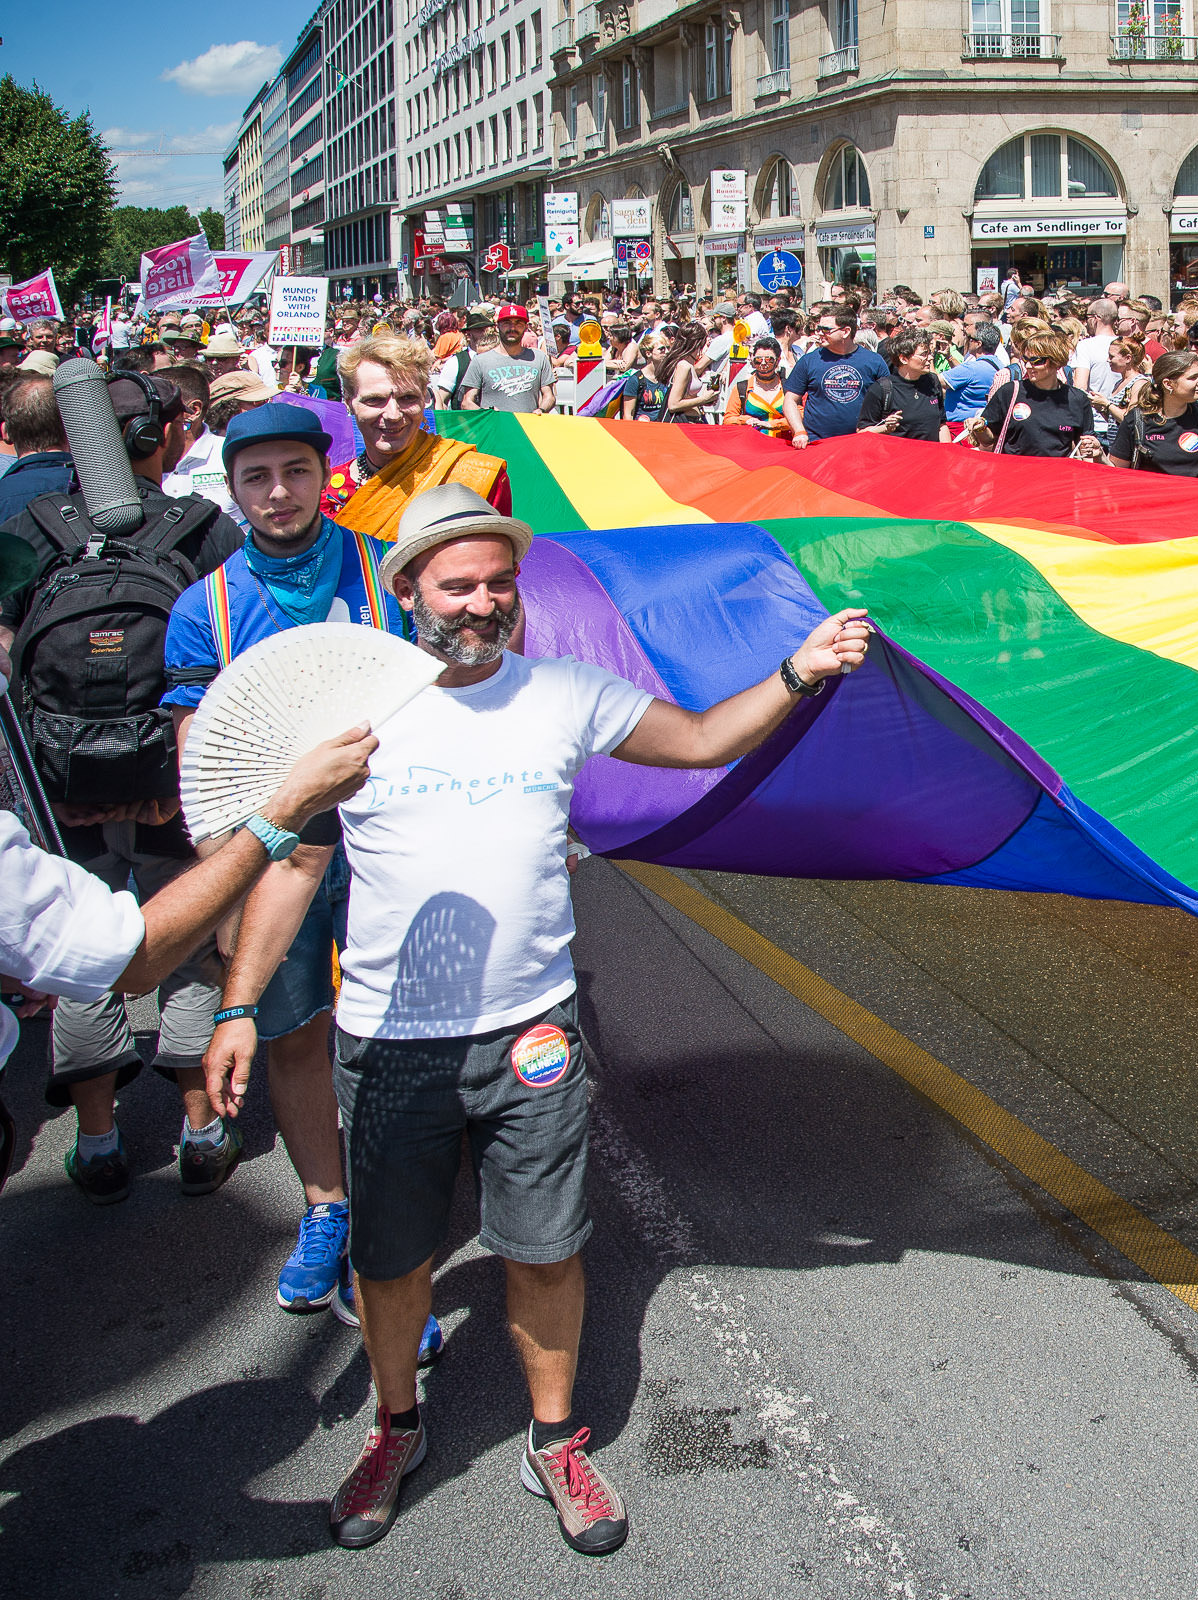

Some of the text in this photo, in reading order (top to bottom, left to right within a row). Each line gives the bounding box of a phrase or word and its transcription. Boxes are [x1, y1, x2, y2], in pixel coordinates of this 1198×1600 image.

[626, 214, 648, 225] dent
[981, 220, 1123, 234] Cafe am Sendlinger Tor
[819, 232, 829, 242] Cafe
[282, 287, 318, 295] MUNICH
[276, 311, 320, 319] ORLANDO
[90, 630, 125, 638] tamrac
